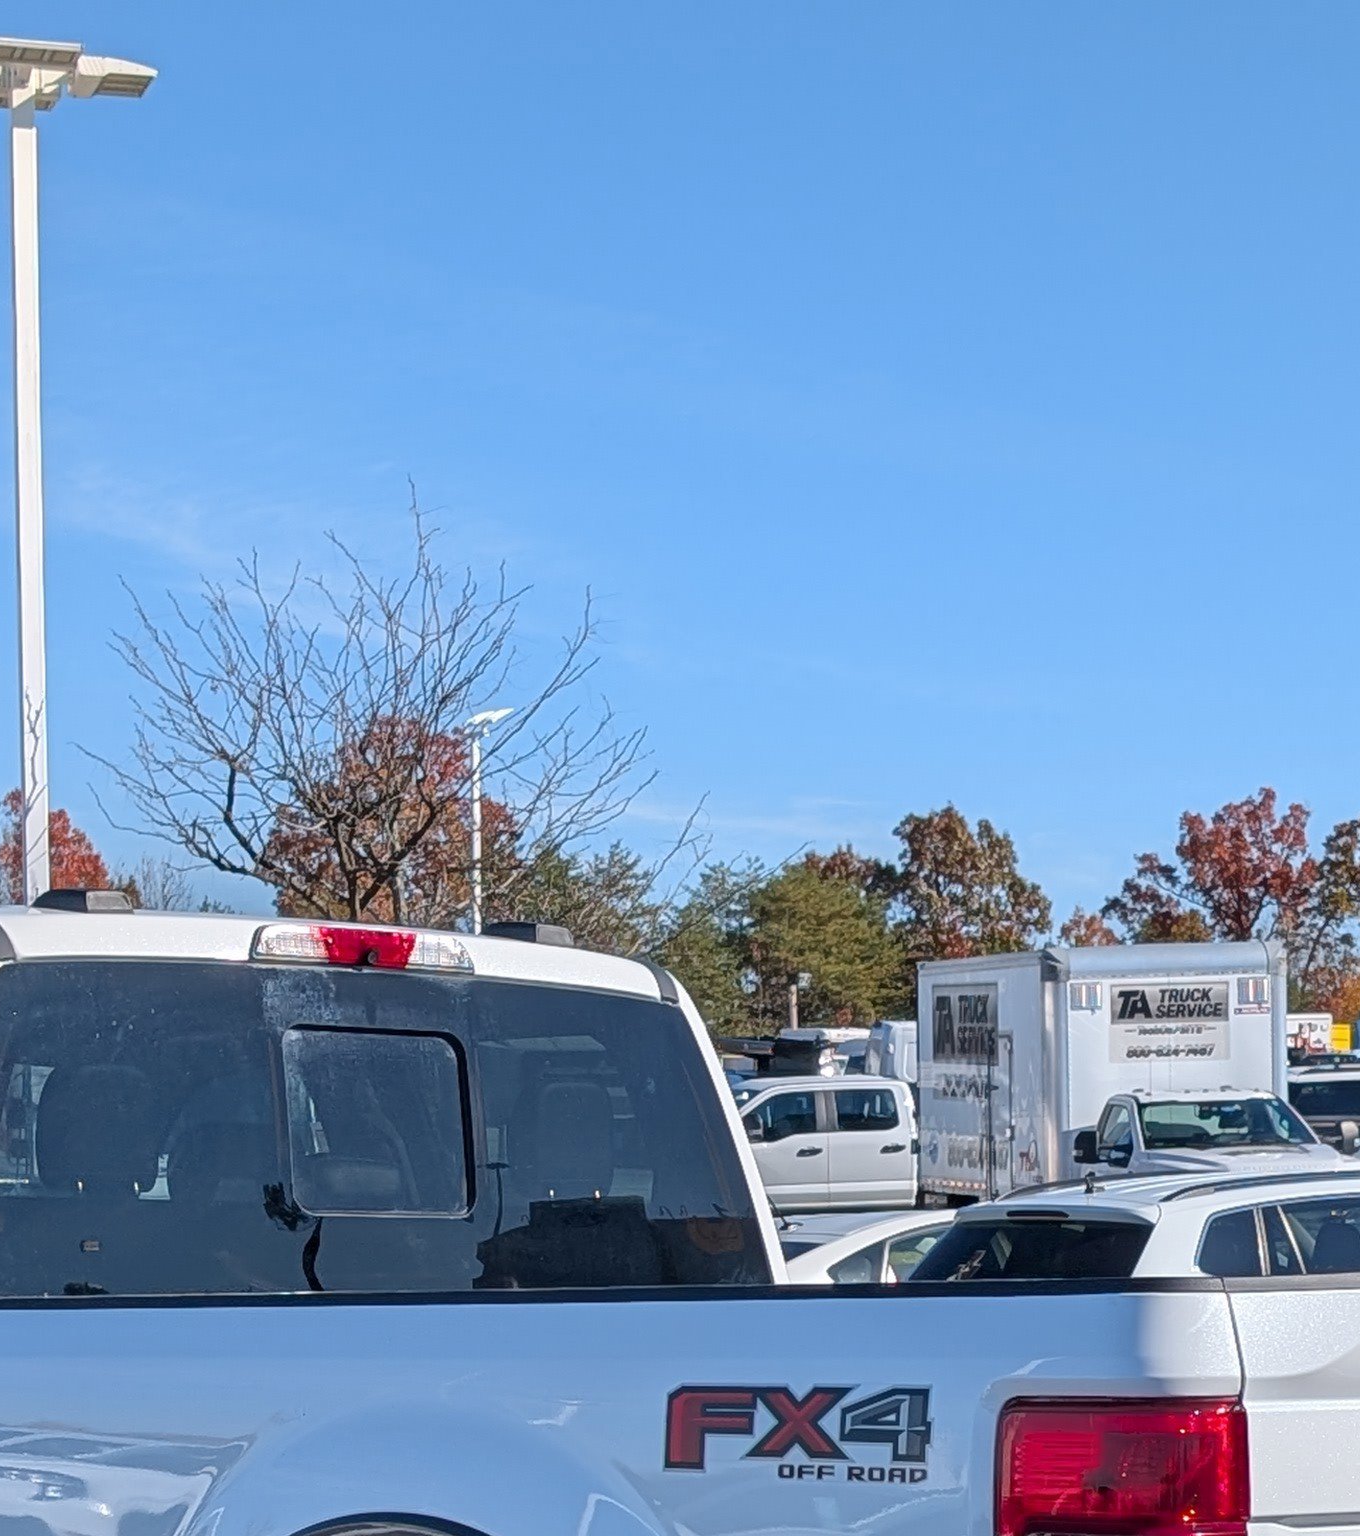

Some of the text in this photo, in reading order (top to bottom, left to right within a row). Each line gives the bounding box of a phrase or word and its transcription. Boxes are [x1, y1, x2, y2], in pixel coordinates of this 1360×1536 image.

[1117, 989, 1153, 1020] TA
[1158, 987, 1214, 1004] TRUCK
[1155, 1002, 1223, 1019] SERVICE
[663, 1383, 932, 1472] FX4
[778, 1464, 927, 1484] OFF ROAD
